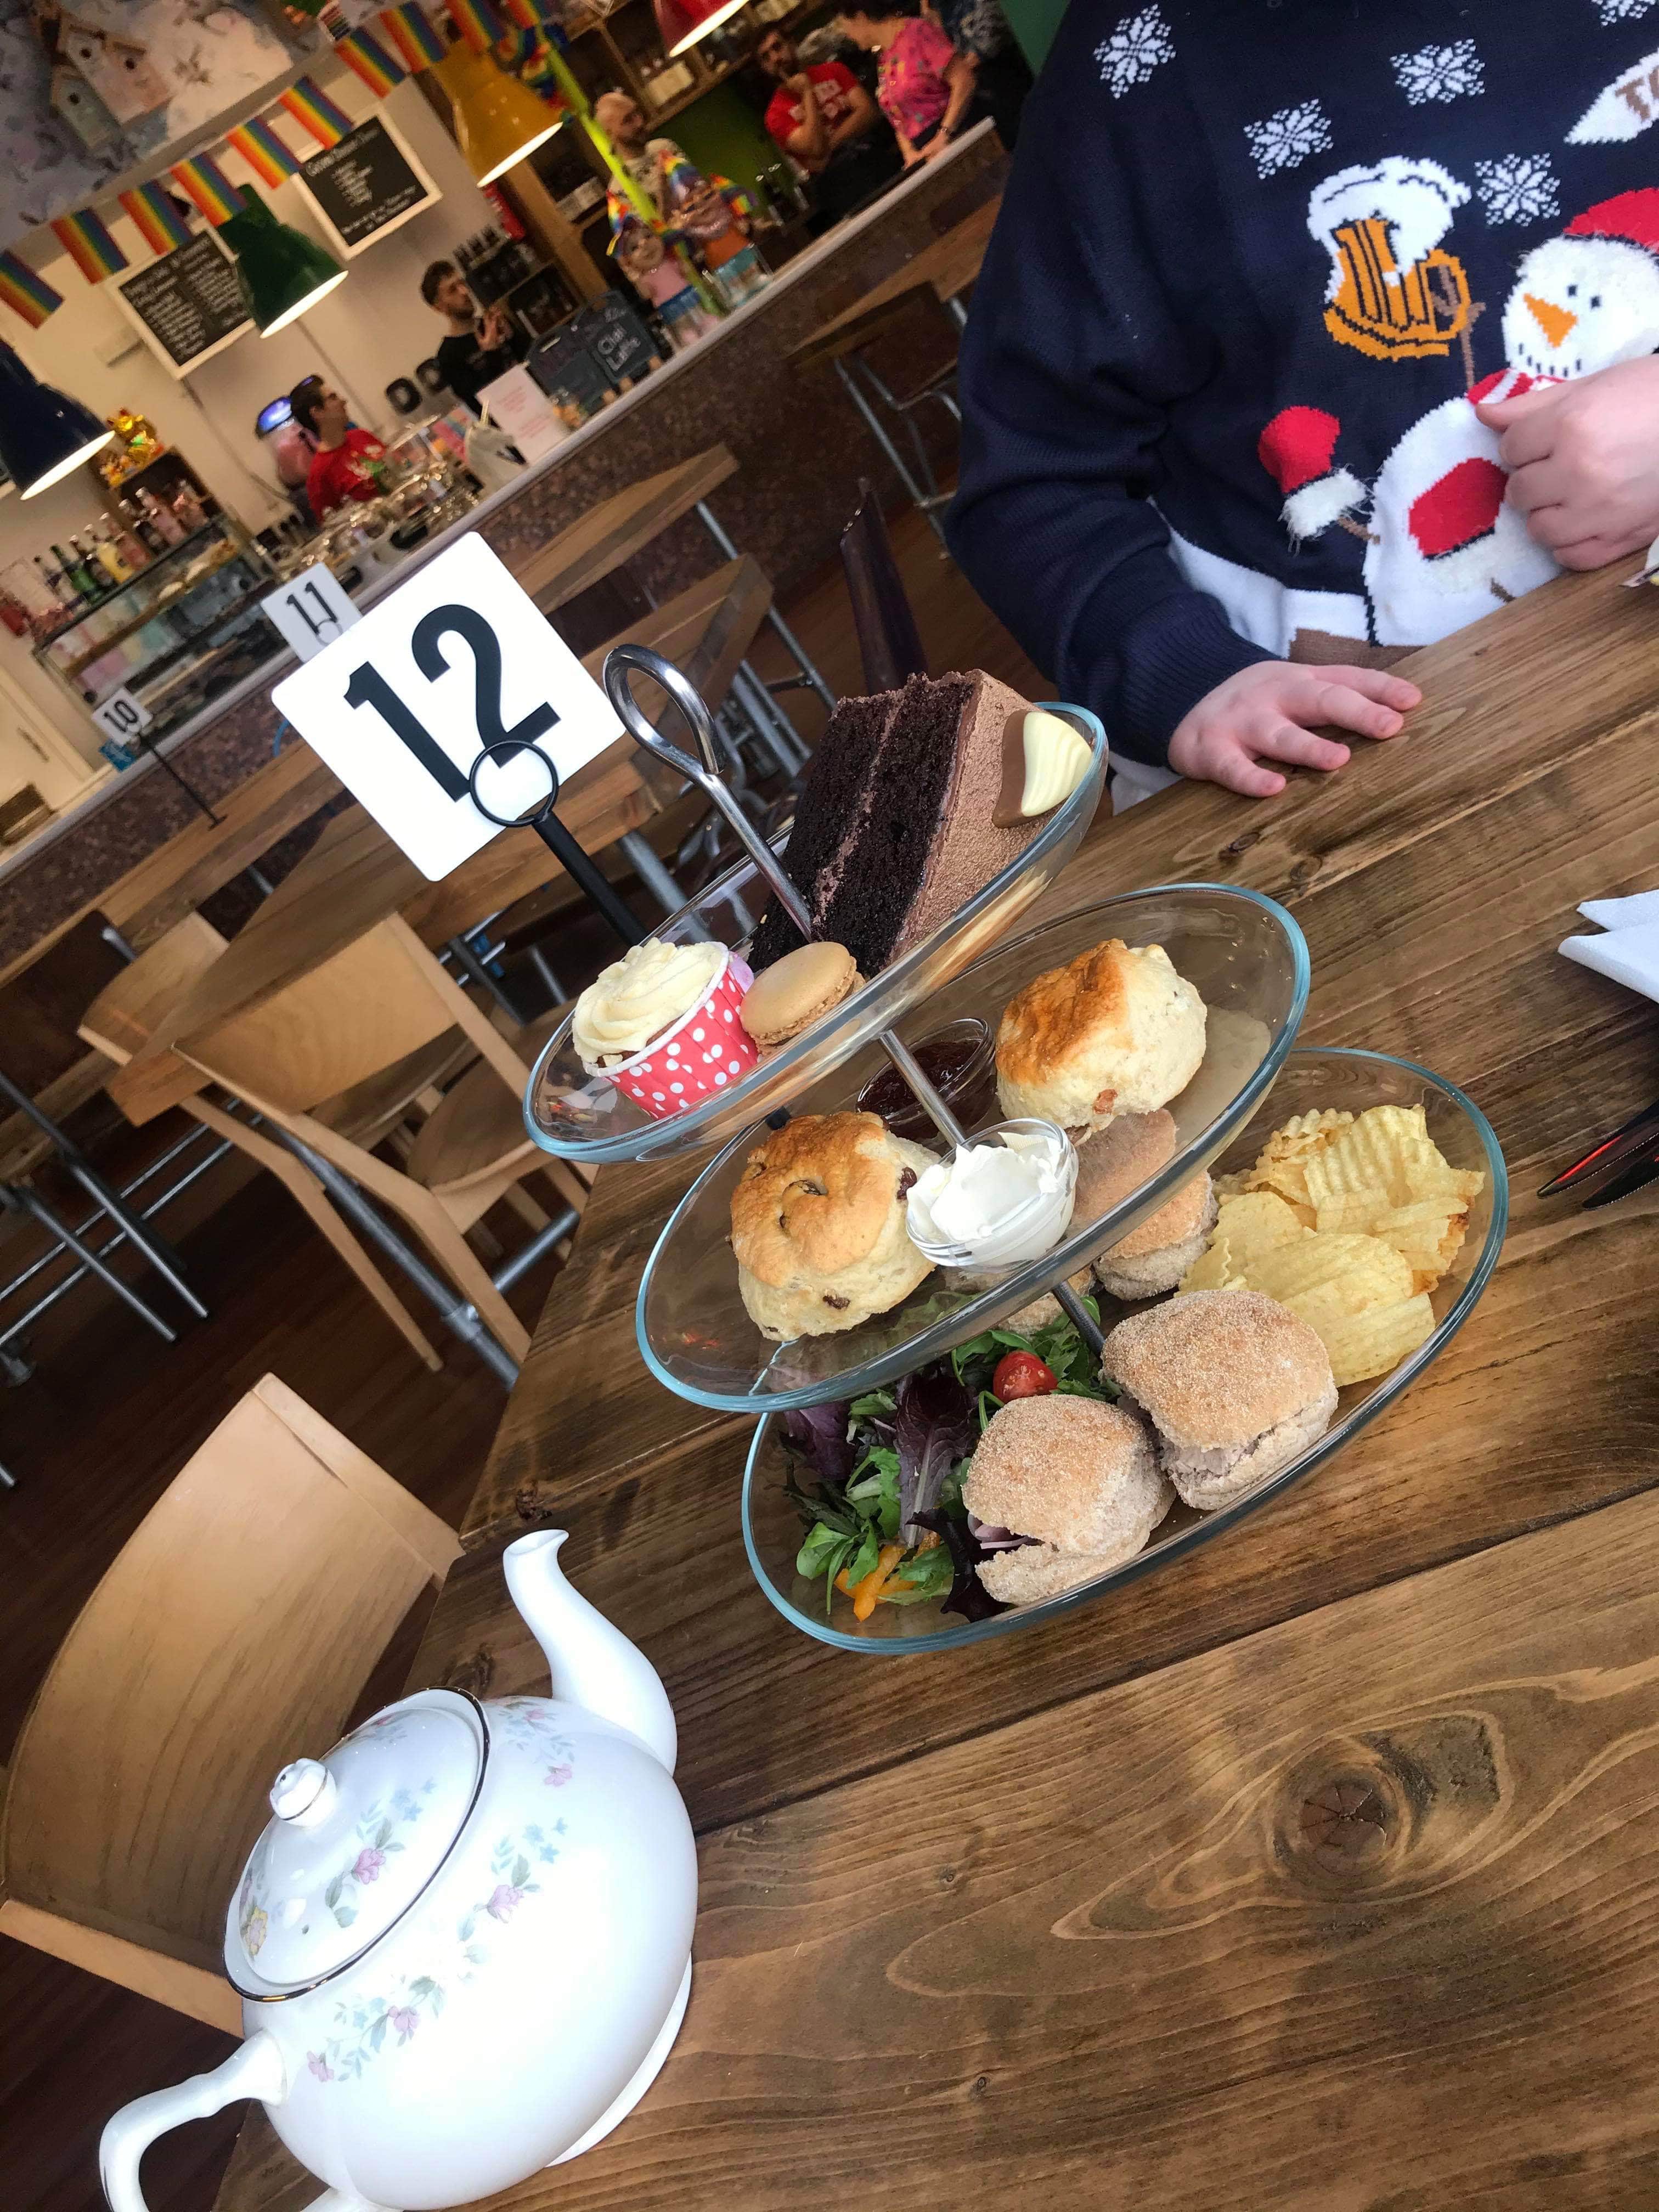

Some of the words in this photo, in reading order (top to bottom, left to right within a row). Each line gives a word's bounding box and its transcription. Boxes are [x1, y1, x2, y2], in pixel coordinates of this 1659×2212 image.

[286, 582, 337, 635] 11
[103, 699, 139, 733] 10
[343, 603, 561, 803] 12
